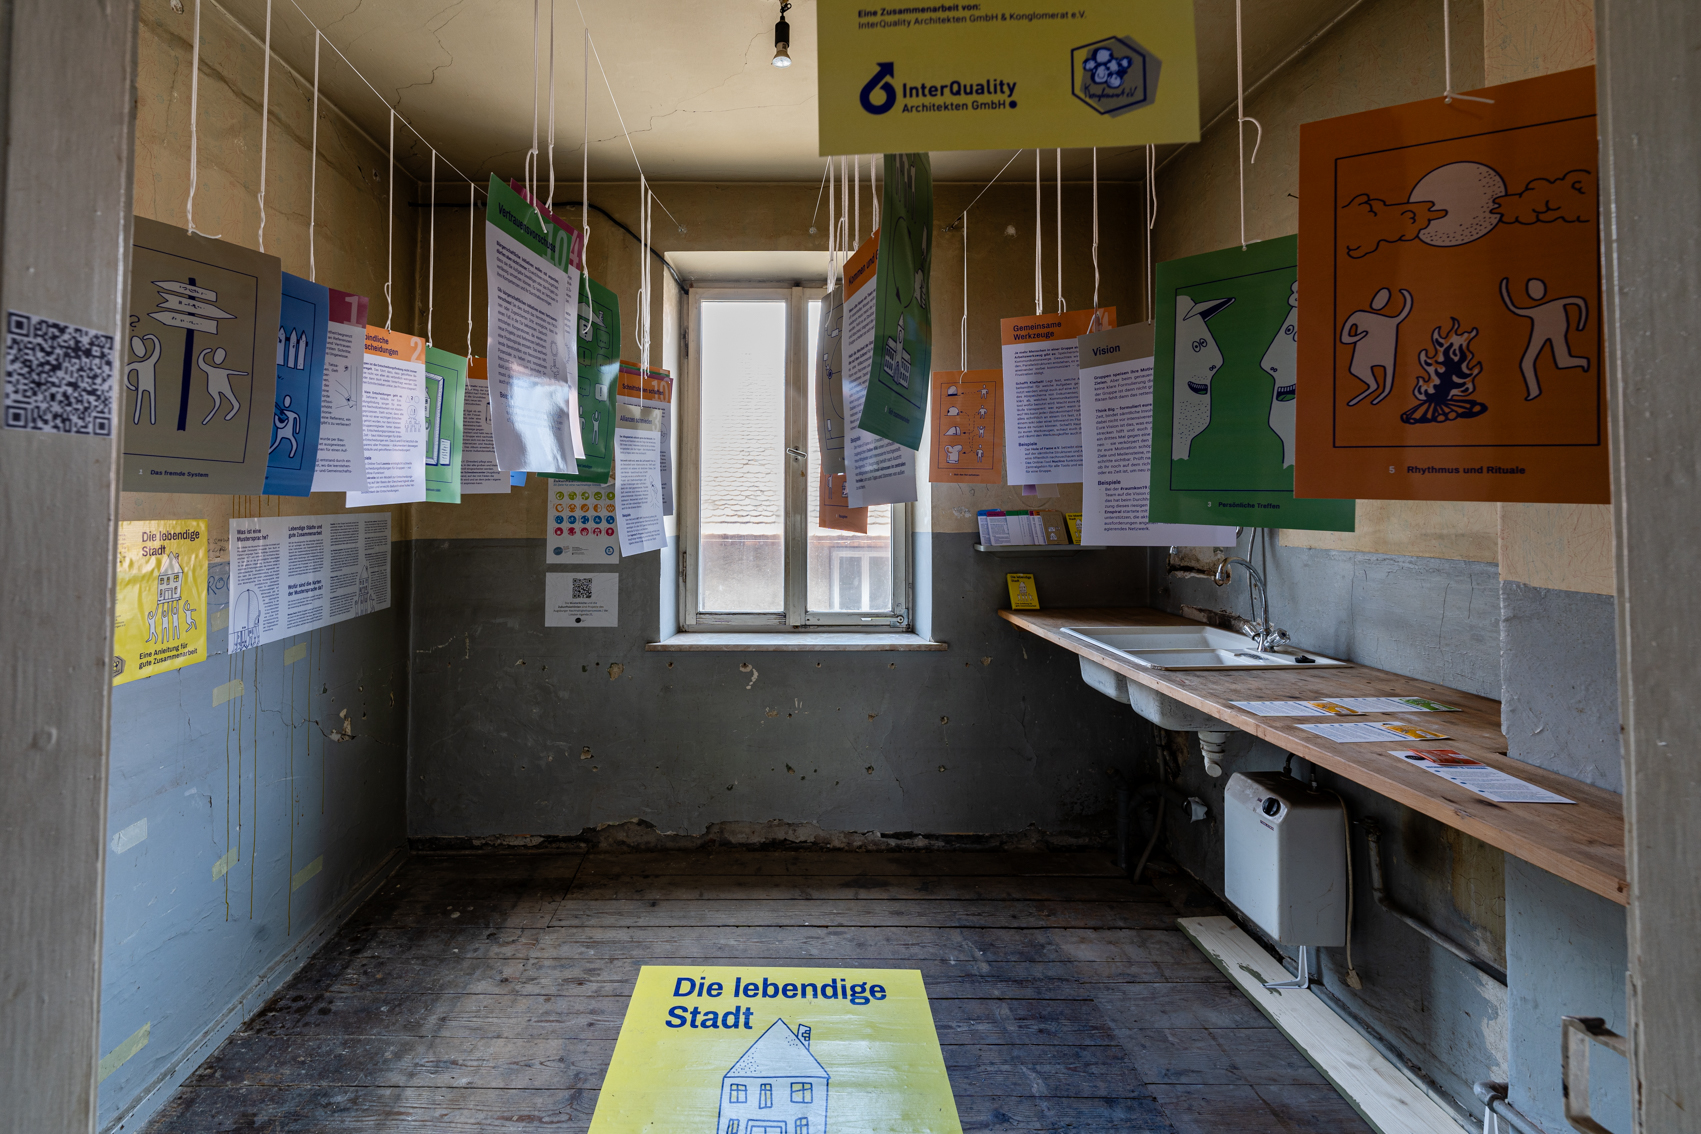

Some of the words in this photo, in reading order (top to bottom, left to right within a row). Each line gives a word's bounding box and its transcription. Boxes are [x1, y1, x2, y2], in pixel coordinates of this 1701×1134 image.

[858, 8, 877, 18] Eine
[880, 4, 959, 17] Zusammenarbeit
[961, 4, 981, 12] von:
[858, 18, 911, 29] InterQuality
[914, 14, 967, 26] Architekten
[970, 13, 998, 22] GmbH
[1000, 13, 1007, 21] &
[1010, 12, 1068, 22] Konglomerat
[1071, 11, 1086, 19] e.V.
[902, 78, 1017, 98] InterQuality
[901, 100, 968, 113] Architekten
[971, 99, 1006, 110] GmbH
[498, 202, 556, 253] Vertrauensvorschuss
[542, 223, 567, 270] 10
[866, 252, 875, 269] und
[343, 295, 362, 328] 1
[1013, 321, 1062, 332] Gemeinsame
[1013, 331, 1054, 340] Werkzeuge
[410, 336, 422, 364] 2
[1092, 345, 1121, 357] Vision
[620, 415, 635, 423] Allianzen
[1389, 466, 1395, 474] 5
[1407, 465, 1460, 475] Rhythmus
[1463, 466, 1483, 474] und
[1486, 466, 1526, 474] Rituale
[142, 531, 156, 542] Die
[159, 529, 200, 541] lebendige
[237, 534, 268, 542] Mustersprache?
[142, 545, 166, 557] Stadt
[153, 645, 179, 656] Anleitung
[139, 660, 152, 670] gute
[153, 648, 197, 664] Zusammenarbeit
[673, 977, 723, 998] Die
[733, 977, 887, 1006] lebendige
[665, 1006, 754, 1030] Stadt
